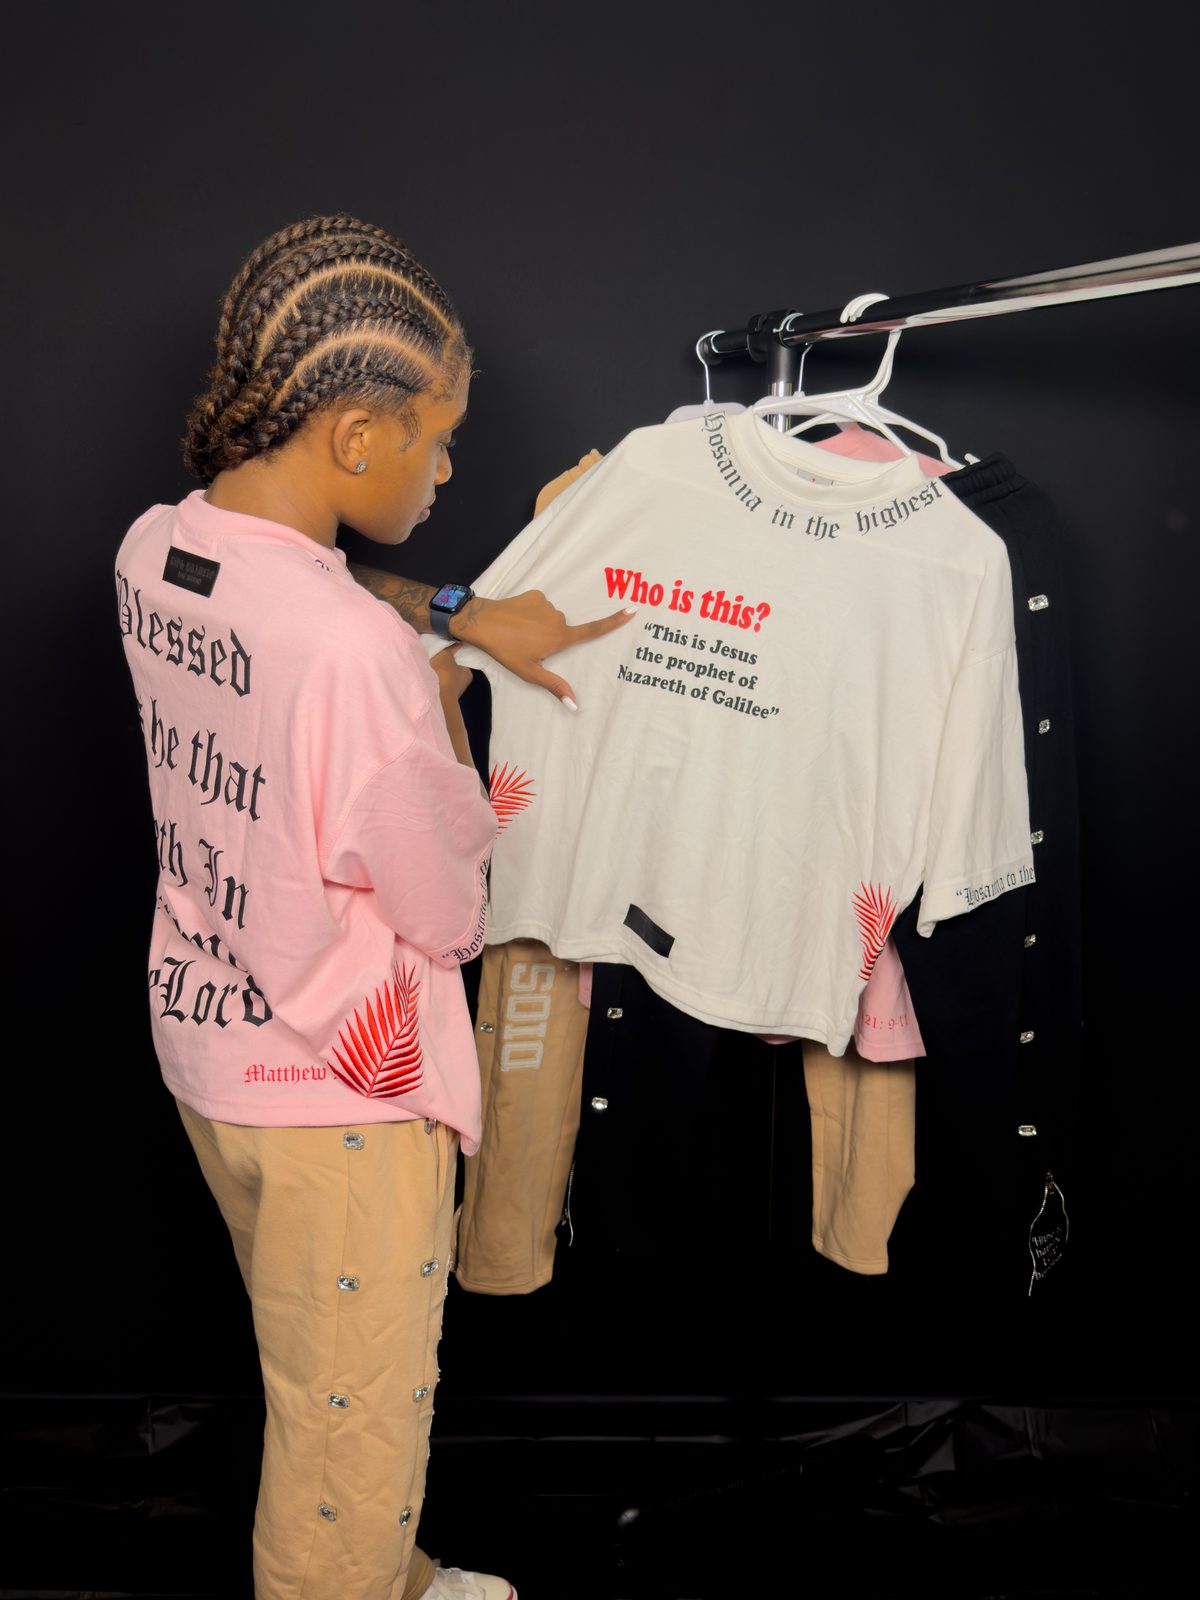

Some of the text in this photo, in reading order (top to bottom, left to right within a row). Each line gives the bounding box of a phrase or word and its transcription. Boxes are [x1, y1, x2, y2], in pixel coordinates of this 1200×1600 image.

[701, 411, 943, 541] Hosanna in the highest
[116, 569, 252, 697] Blessed
[604, 567, 770, 632] Who is this?
[617, 664, 686, 696] Nazareth
[690, 686, 709, 701] of
[635, 646, 758, 690] the prophet of
[691, 634, 706, 651] is
[709, 639, 758, 665] Jesus
[188, 728, 266, 822] that
[198, 838, 249, 930] In
[160, 956, 273, 1029] Lord
[501, 962, 556, 1073] DIOS
[244, 1063, 327, 1085] Matthew
